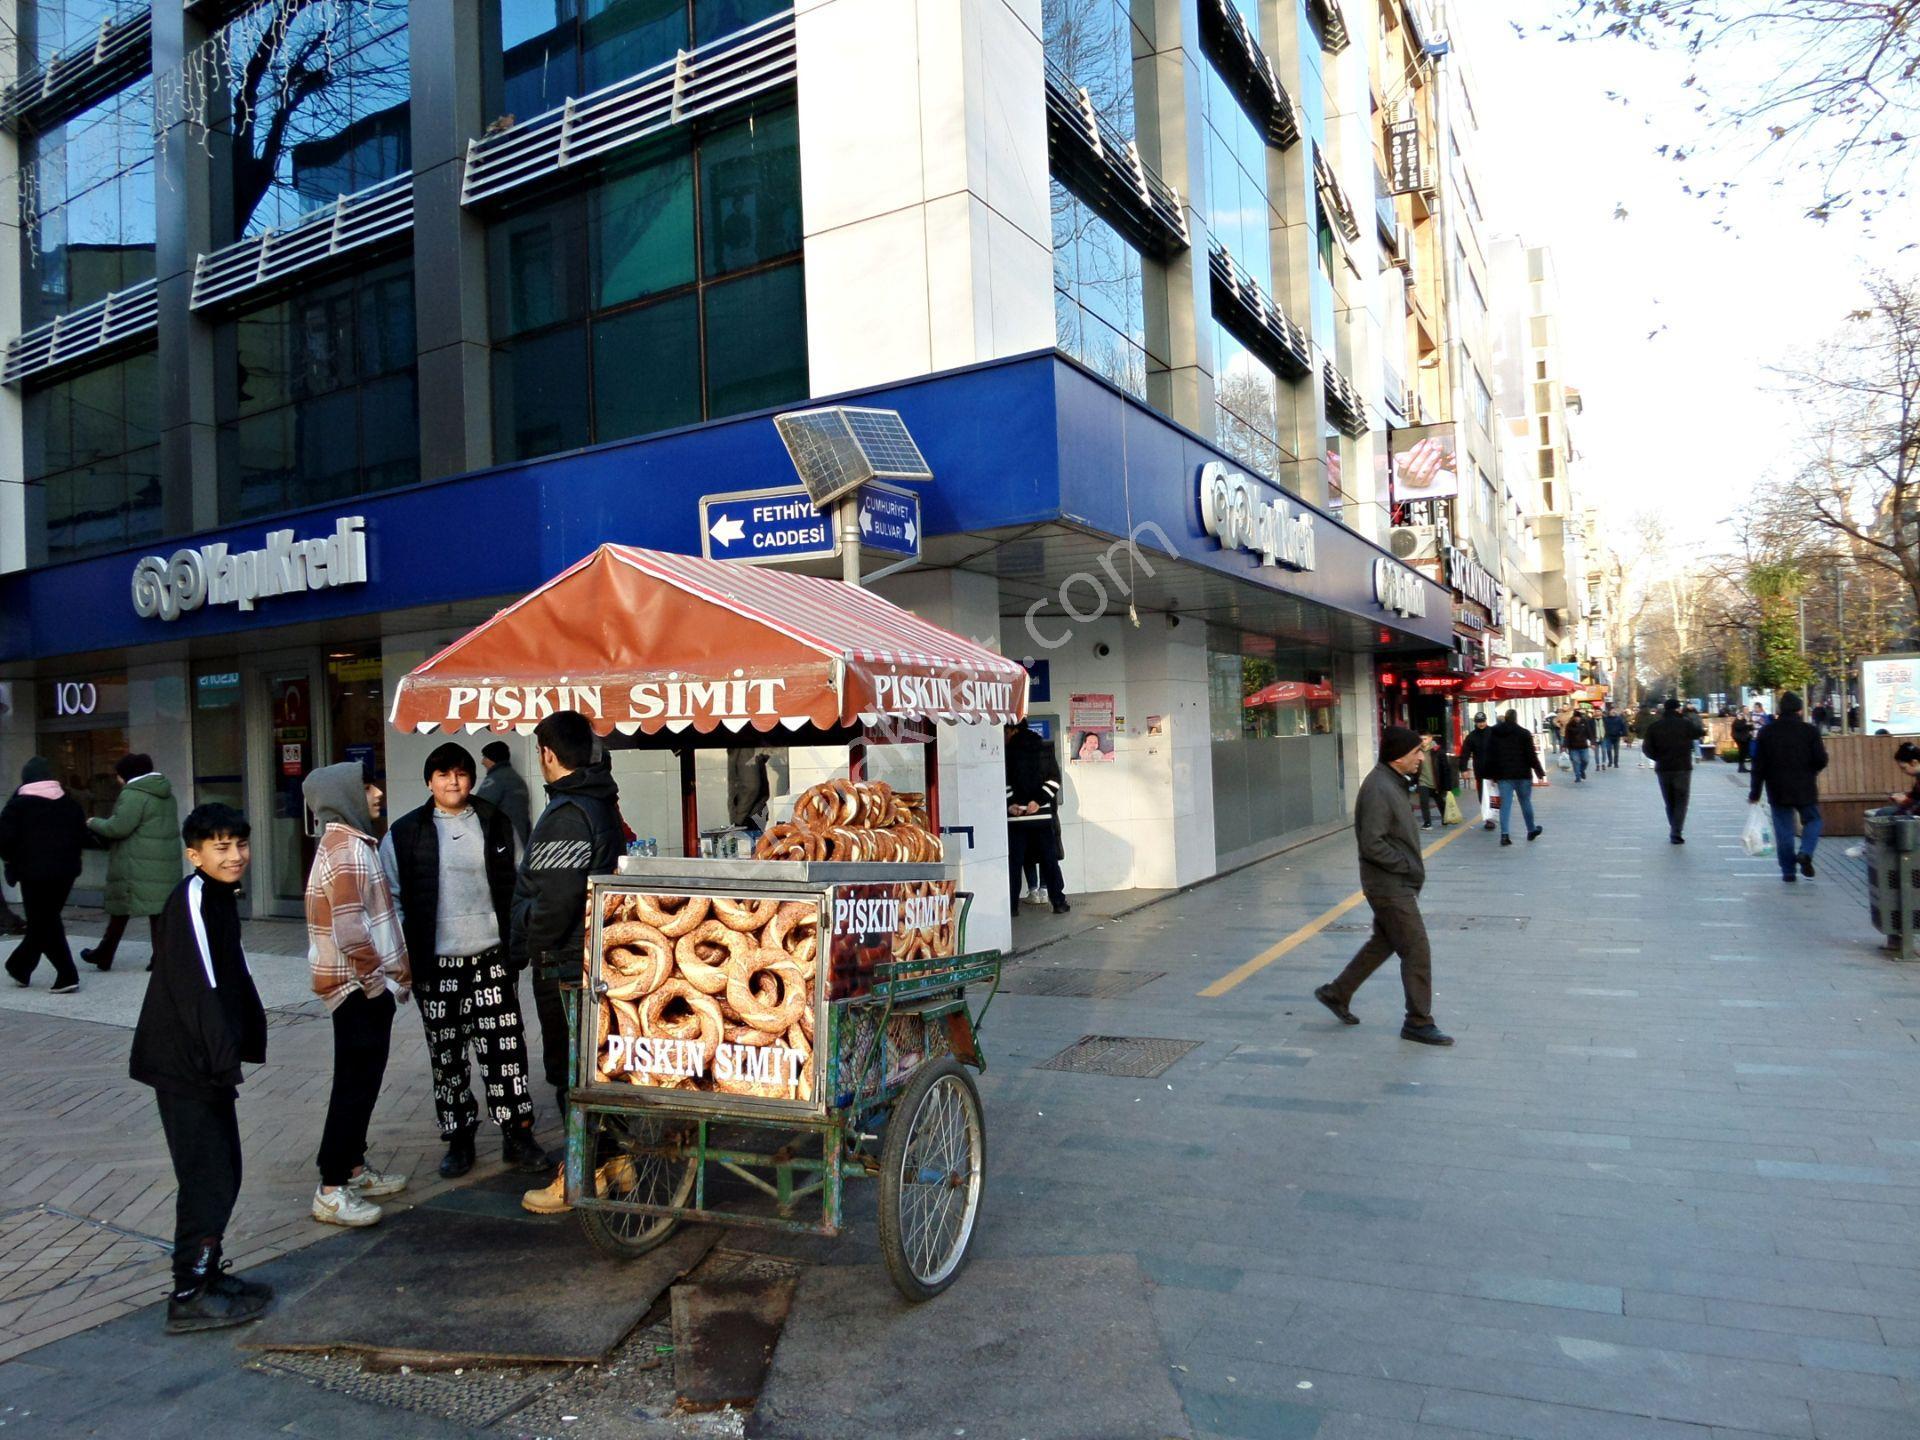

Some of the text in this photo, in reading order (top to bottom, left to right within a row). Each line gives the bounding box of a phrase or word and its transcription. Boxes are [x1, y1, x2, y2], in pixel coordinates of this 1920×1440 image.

[753, 501, 821, 523] FETHİYE
[865, 495, 909, 518] CUMHURİYET
[752, 523, 825, 548] CADDESİ
[446, 668, 786, 730] PİŞKİN SİMİT
[873, 664, 1013, 718] PİŞKİN SİMİT
[834, 889, 950, 943] PİŞKİN SİMİT
[606, 1027, 810, 1087] PİŞKİN SİMİT
